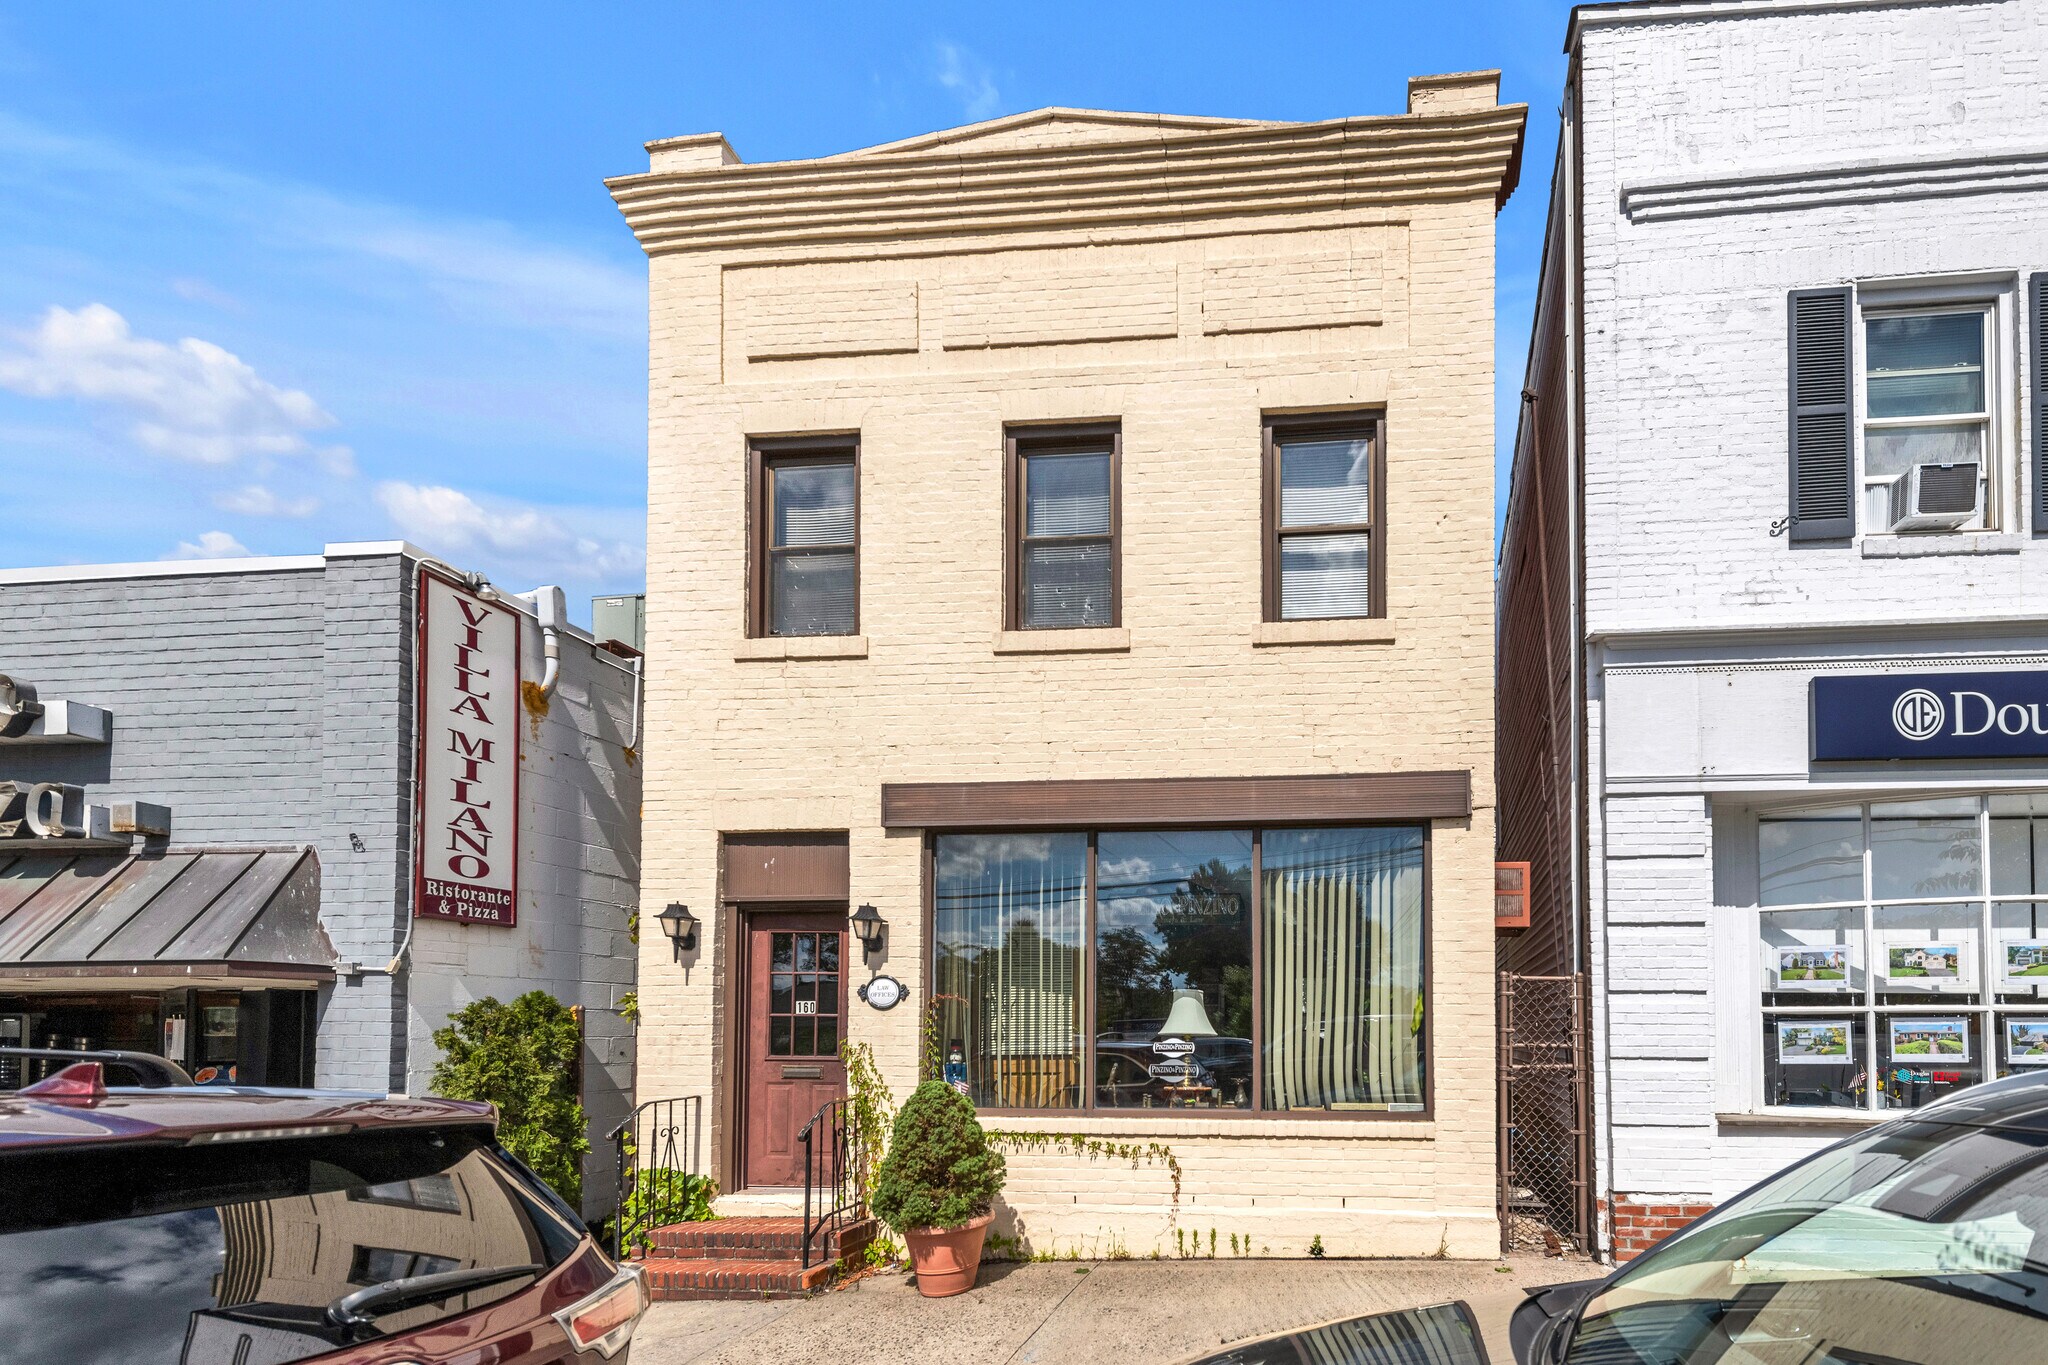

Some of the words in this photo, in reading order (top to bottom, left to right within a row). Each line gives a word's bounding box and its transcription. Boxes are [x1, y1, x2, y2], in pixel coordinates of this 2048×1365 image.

[450, 595, 494, 726] VILLA
[446, 727, 495, 880] MILANO
[425, 880, 511, 906] Ristorante
[438, 899, 451, 914] &
[456, 901, 499, 920] Pizza
[797, 1001, 815, 1013] 160
